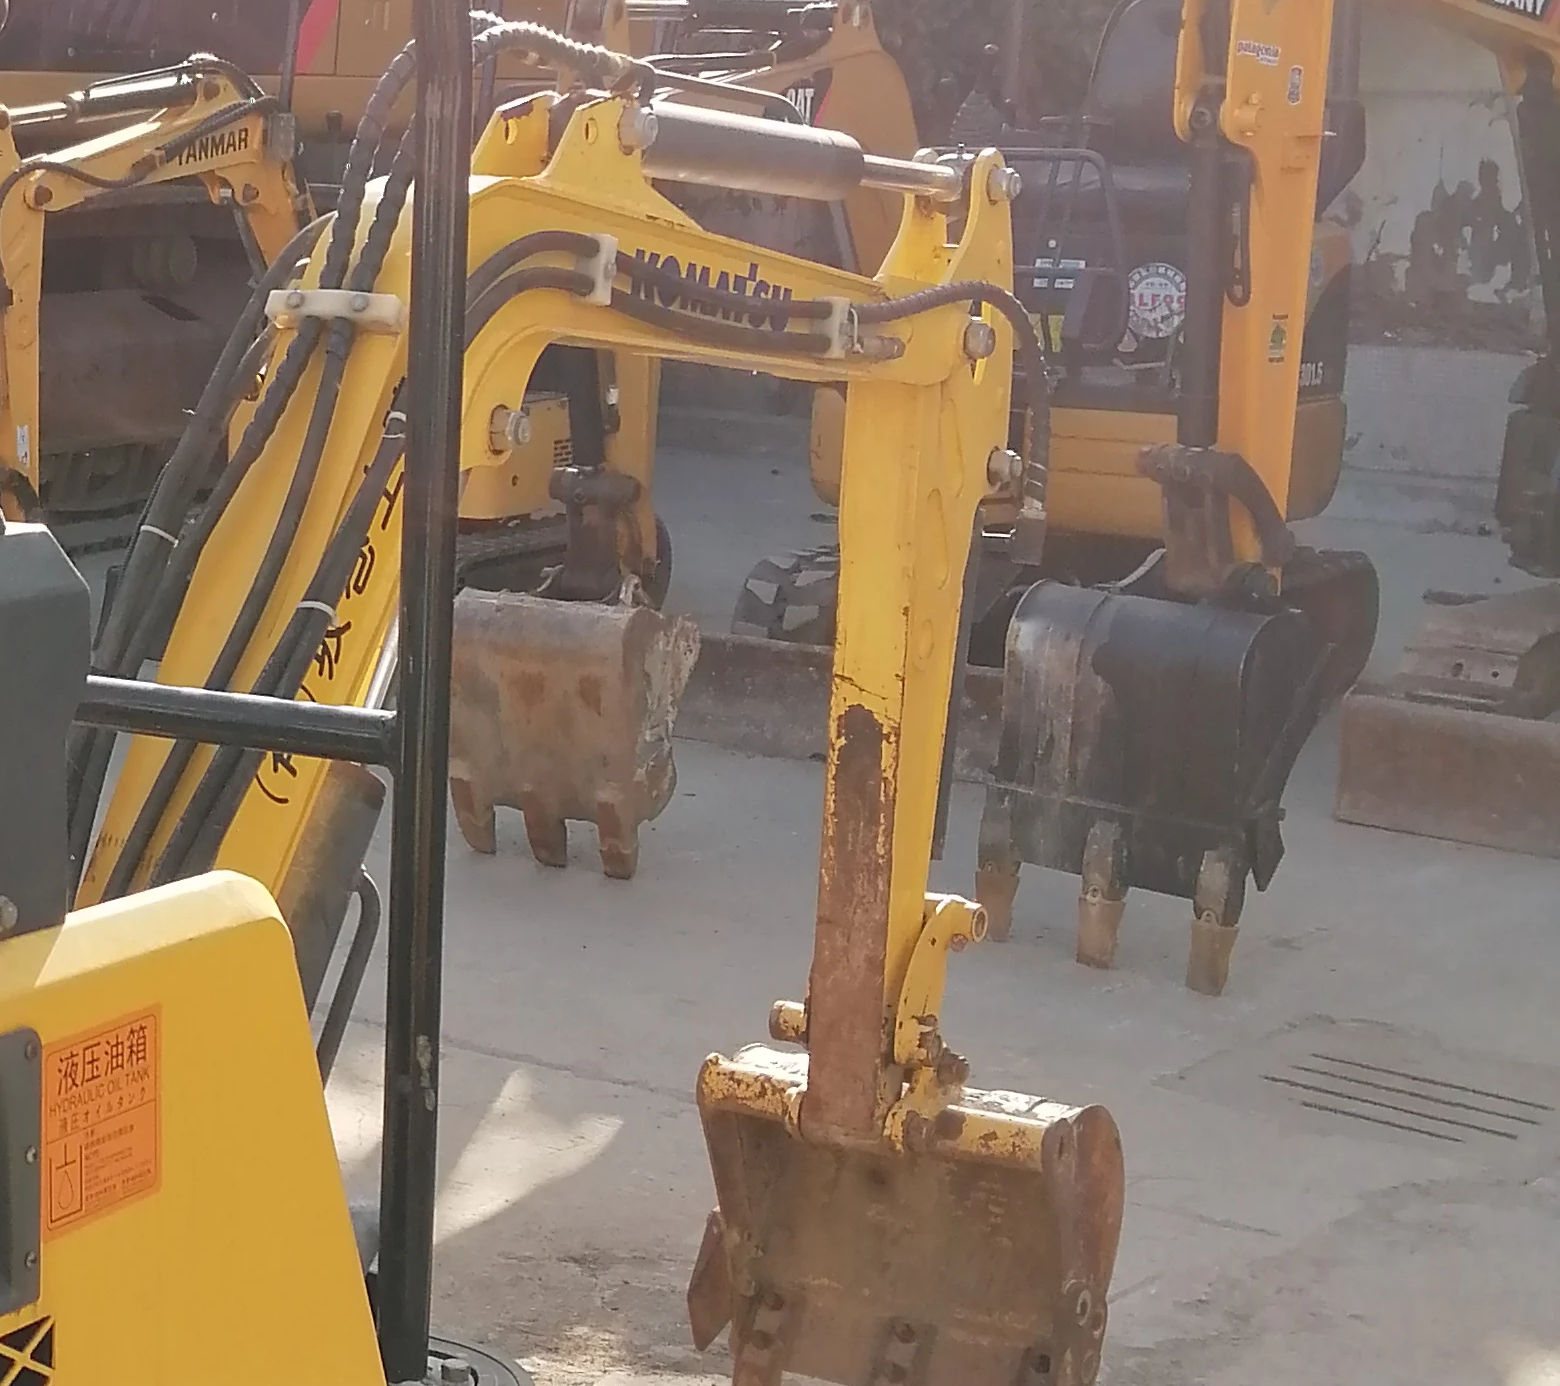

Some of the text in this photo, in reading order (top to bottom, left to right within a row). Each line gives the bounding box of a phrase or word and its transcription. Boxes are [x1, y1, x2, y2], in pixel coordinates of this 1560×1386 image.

[57, 1023, 148, 1096] 液压油箱
[48, 1065, 151, 1118] HYDRAULIC OIL TANK
